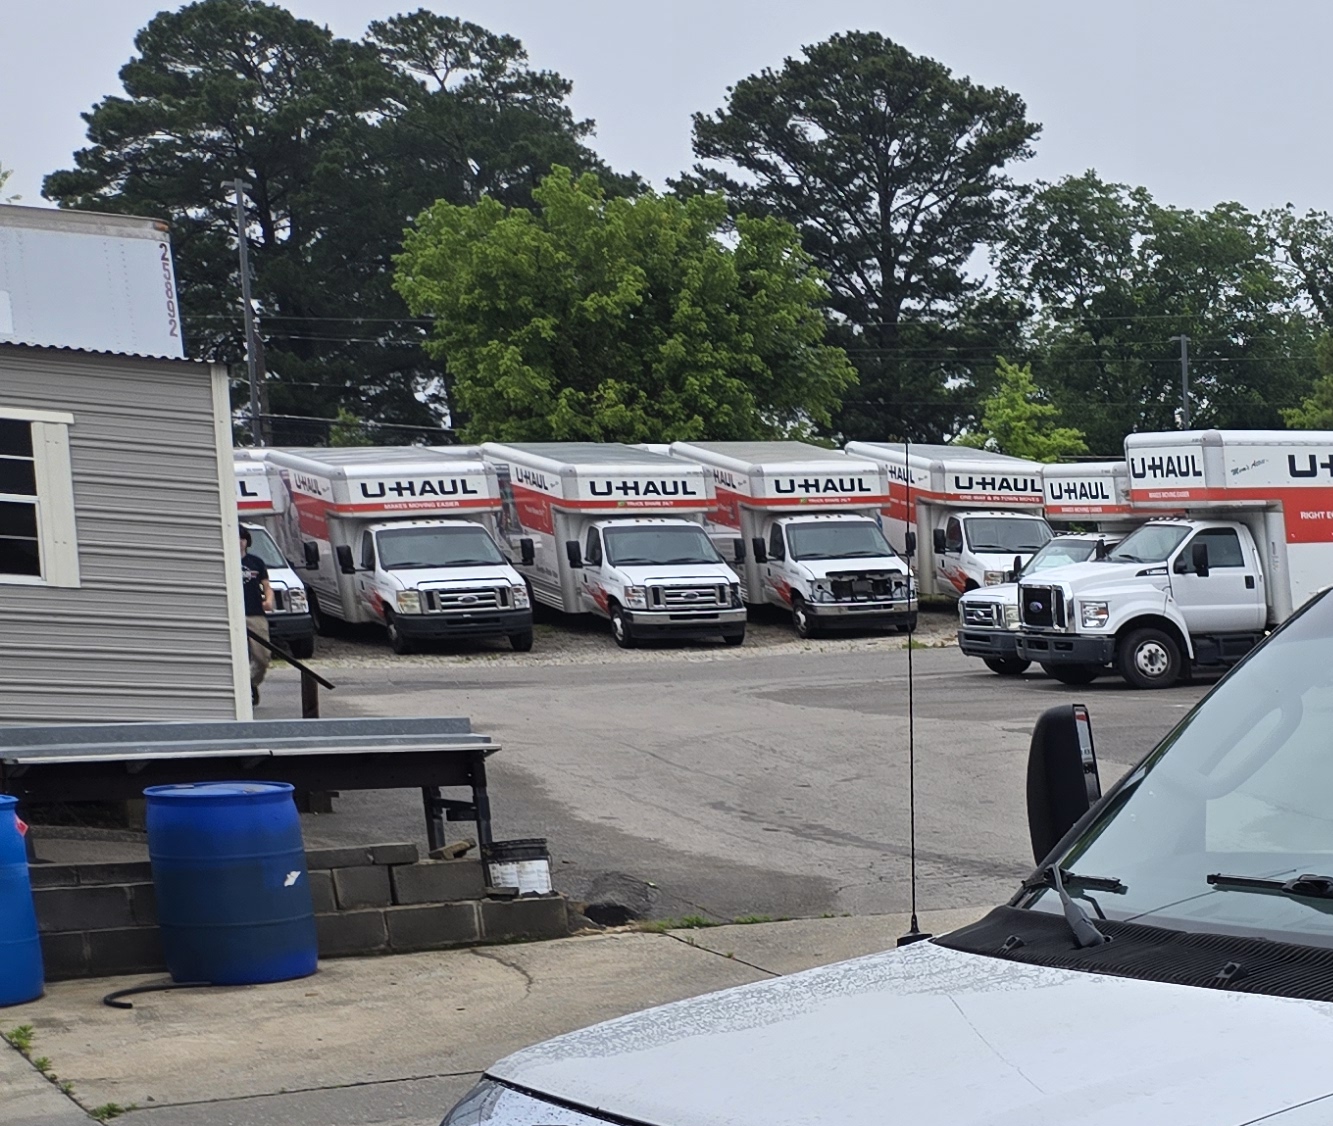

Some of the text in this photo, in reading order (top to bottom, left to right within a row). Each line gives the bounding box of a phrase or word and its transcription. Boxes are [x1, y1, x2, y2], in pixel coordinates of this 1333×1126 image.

[1131, 455, 1202, 478] U-HAUL
[294, 472, 322, 496] U-HAUL
[515, 467, 548, 490] U-HAUL
[774, 478, 871, 493] U-HAUL
[954, 476, 1042, 492] U-HAUL
[360, 479, 478, 498] U-HAUL
[589, 480, 696, 496] U-HAUL
[1050, 482, 1109, 500] U-HAUL
[1300, 511, 1325, 519] RIGHT
